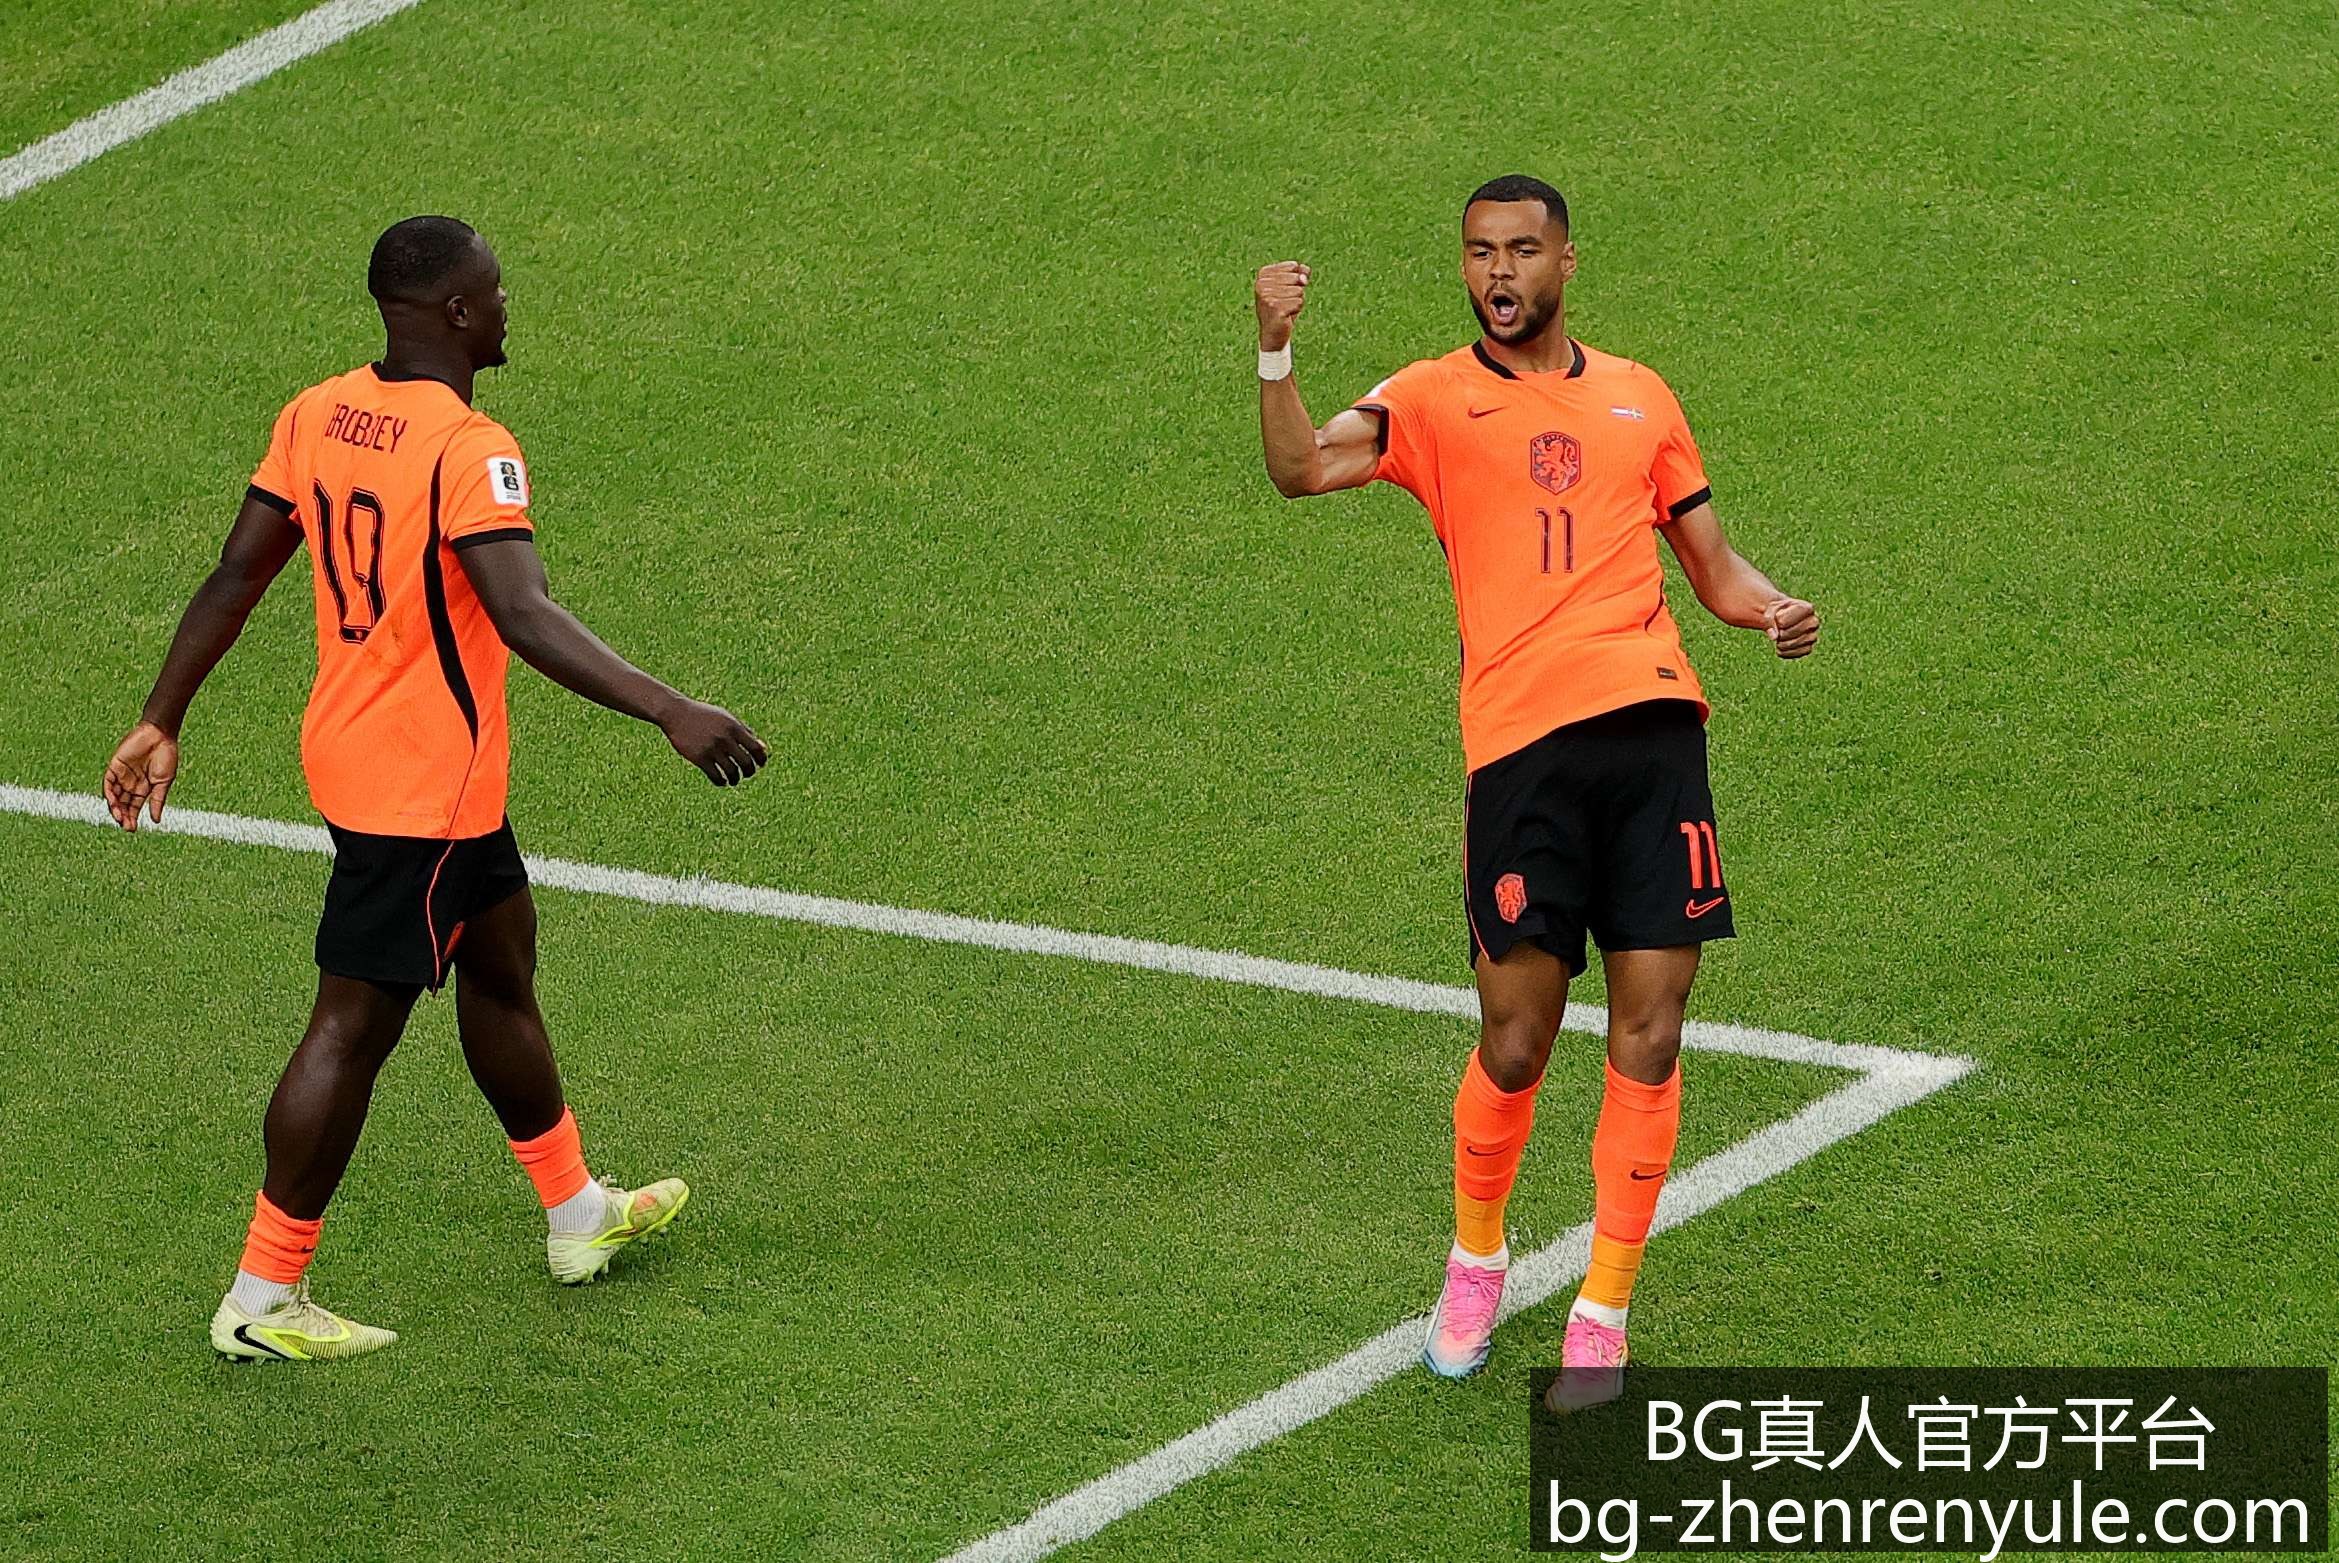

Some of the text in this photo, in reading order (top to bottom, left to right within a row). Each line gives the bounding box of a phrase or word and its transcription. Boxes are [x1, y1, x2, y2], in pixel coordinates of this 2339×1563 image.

[312, 477, 387, 646] 19
[1535, 507, 1574, 574] 11
[1679, 820, 1722, 889] 11
